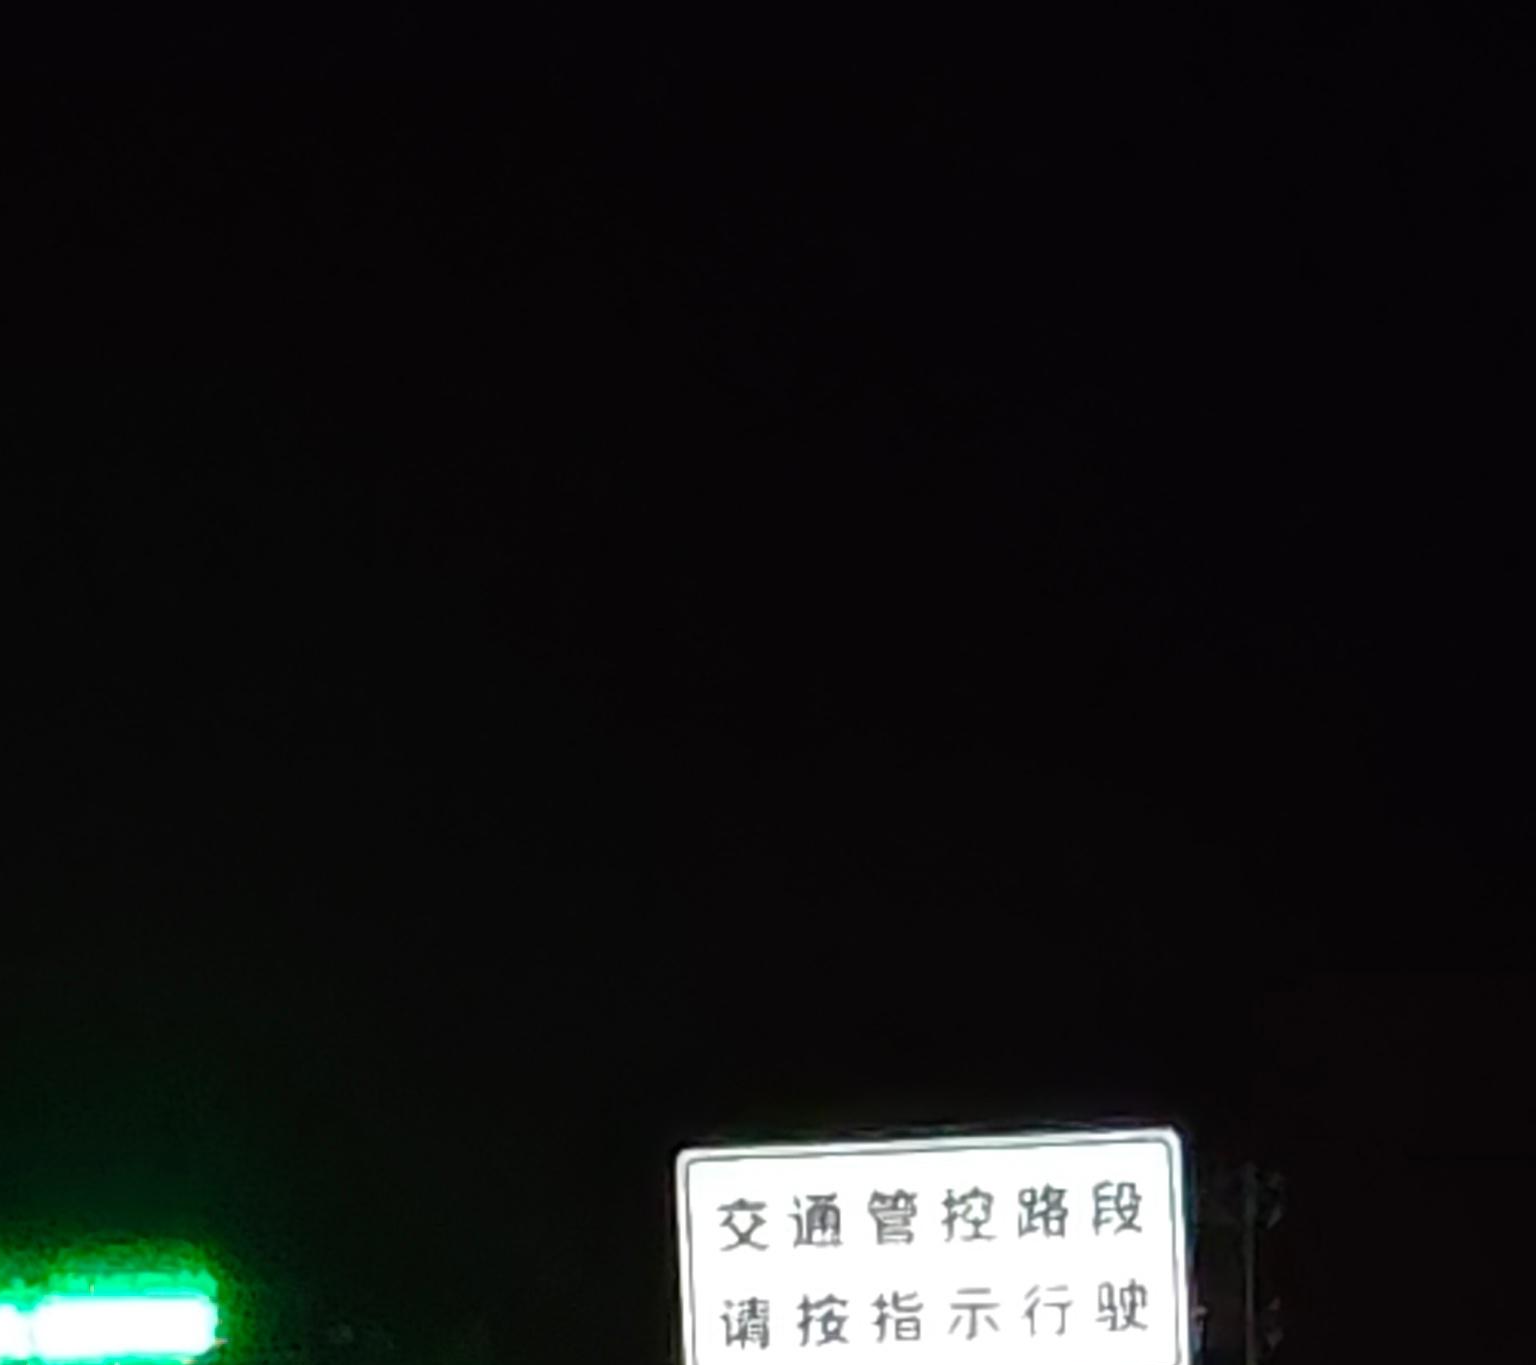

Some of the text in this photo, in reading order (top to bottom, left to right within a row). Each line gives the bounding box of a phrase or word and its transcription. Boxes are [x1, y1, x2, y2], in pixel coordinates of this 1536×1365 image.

[718, 1180, 1144, 1252] 交通管控路段
[720, 1279, 1150, 1350] 请按指示行驶
